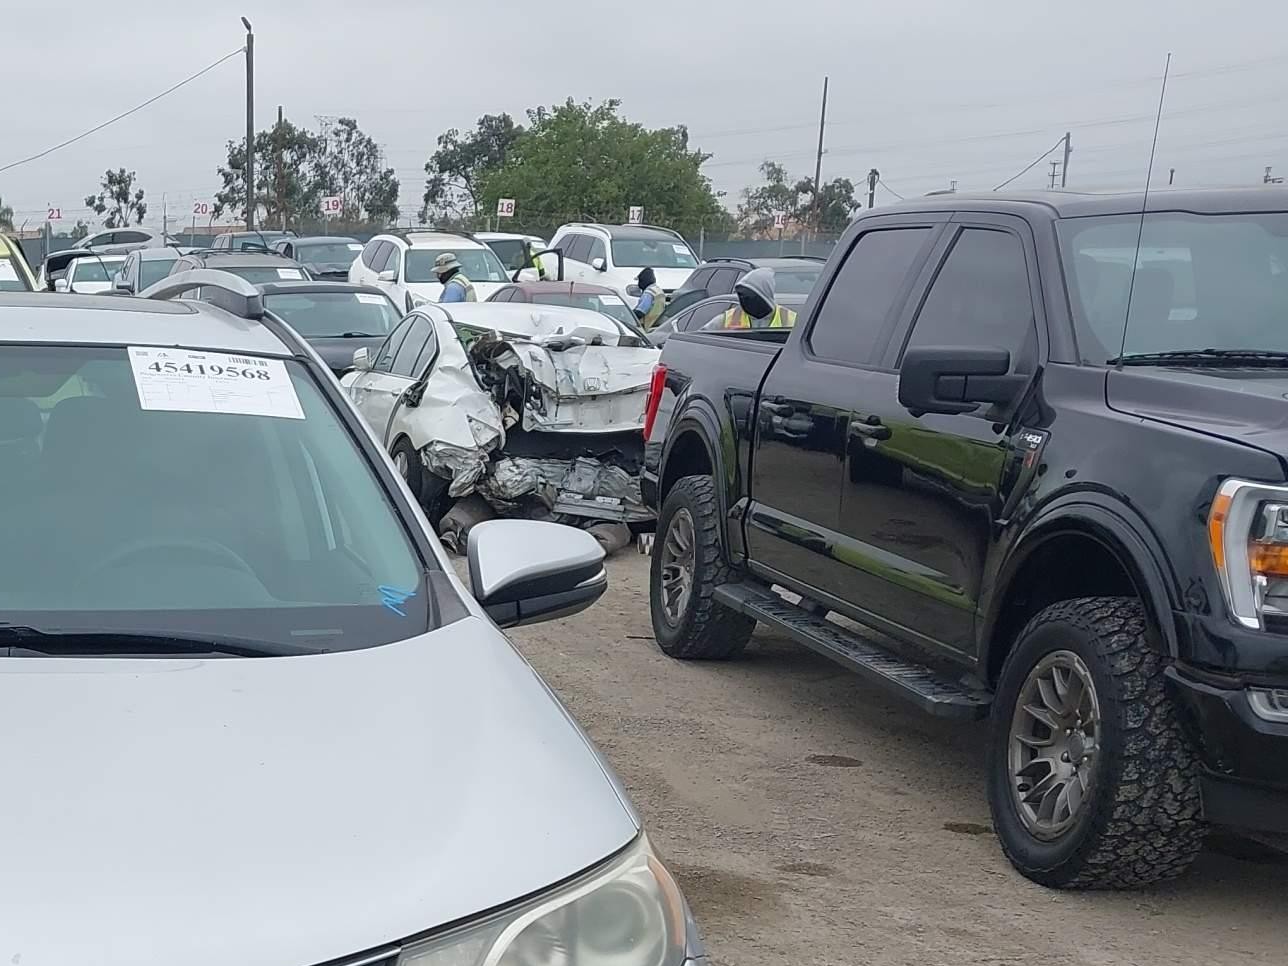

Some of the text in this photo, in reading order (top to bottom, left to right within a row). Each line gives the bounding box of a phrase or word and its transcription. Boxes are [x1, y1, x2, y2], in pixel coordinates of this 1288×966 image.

[194, 203, 208, 214] 20
[324, 200, 339, 211] 19
[499, 202, 513, 213] 18
[48, 208, 62, 219] 21
[148, 361, 271, 381] 45419568
